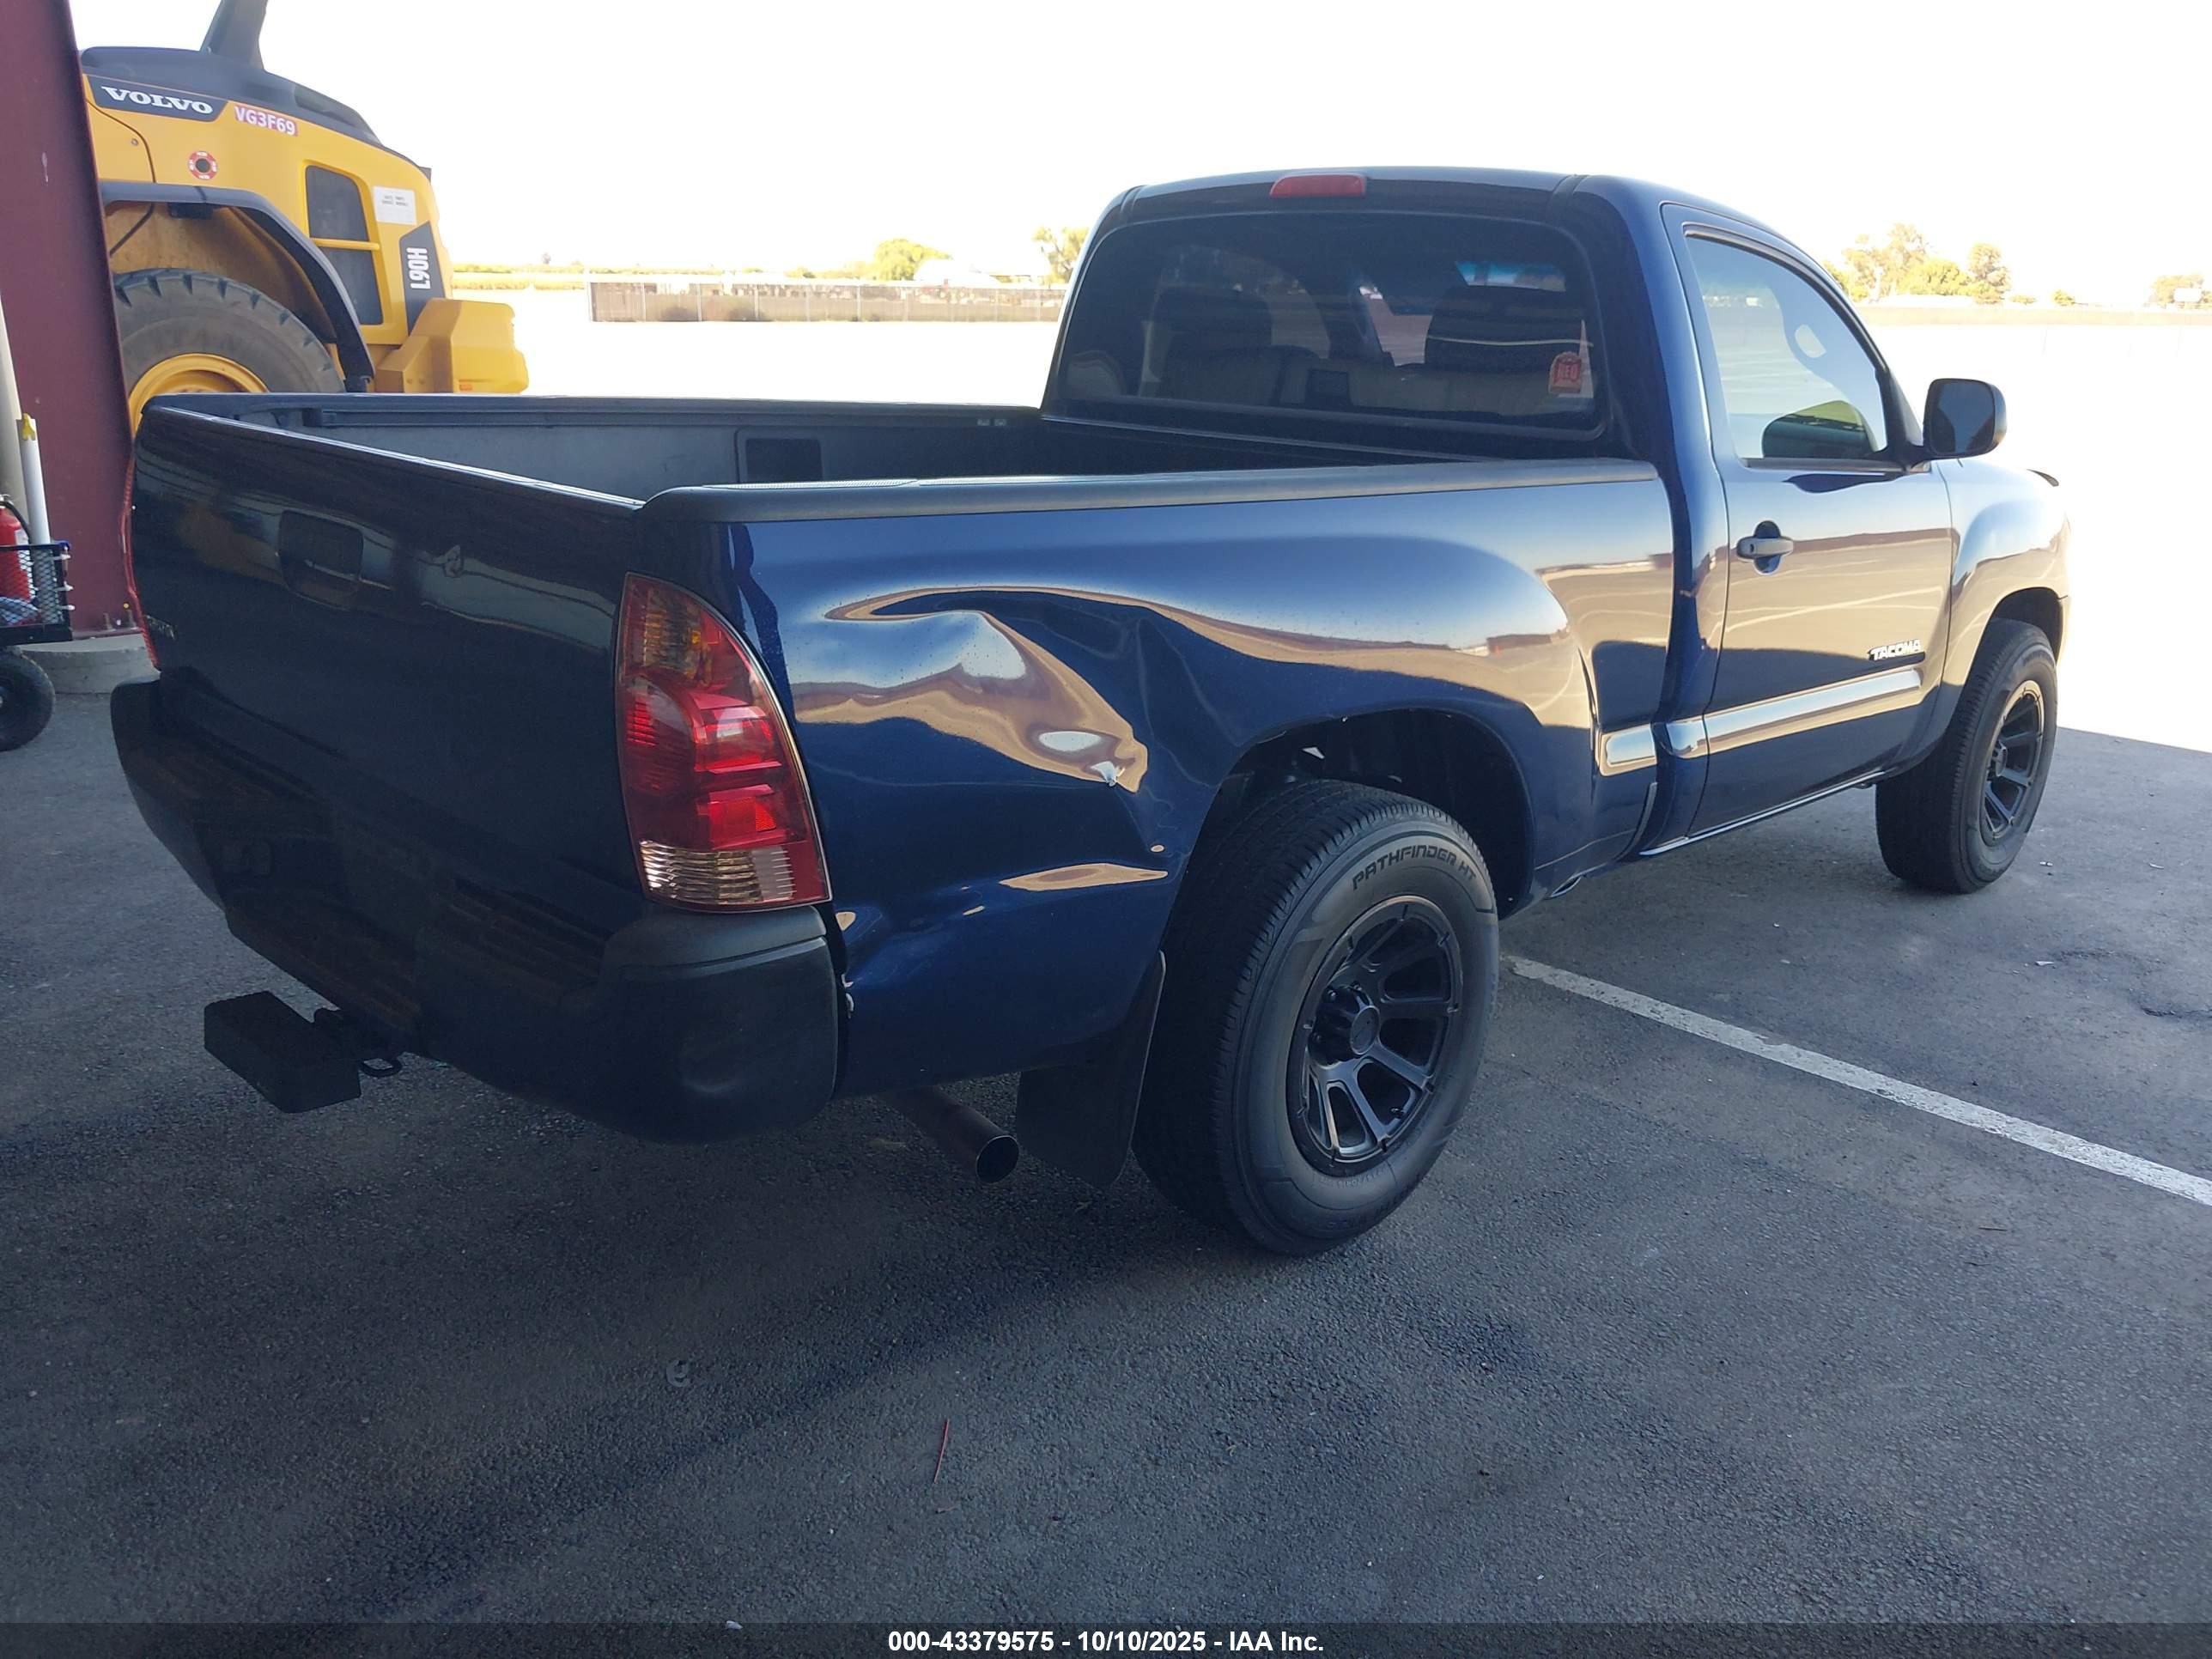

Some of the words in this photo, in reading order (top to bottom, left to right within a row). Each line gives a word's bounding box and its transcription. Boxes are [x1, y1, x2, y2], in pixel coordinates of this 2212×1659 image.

[101, 86, 213, 114] VOLVO
[234, 105, 296, 136] VG3F69
[406, 247, 431, 289] L90H
[1868, 639, 1922, 660] TACOMA
[1352, 845, 1457, 890] PATHFINDER
[1458, 860, 1477, 882] HT
